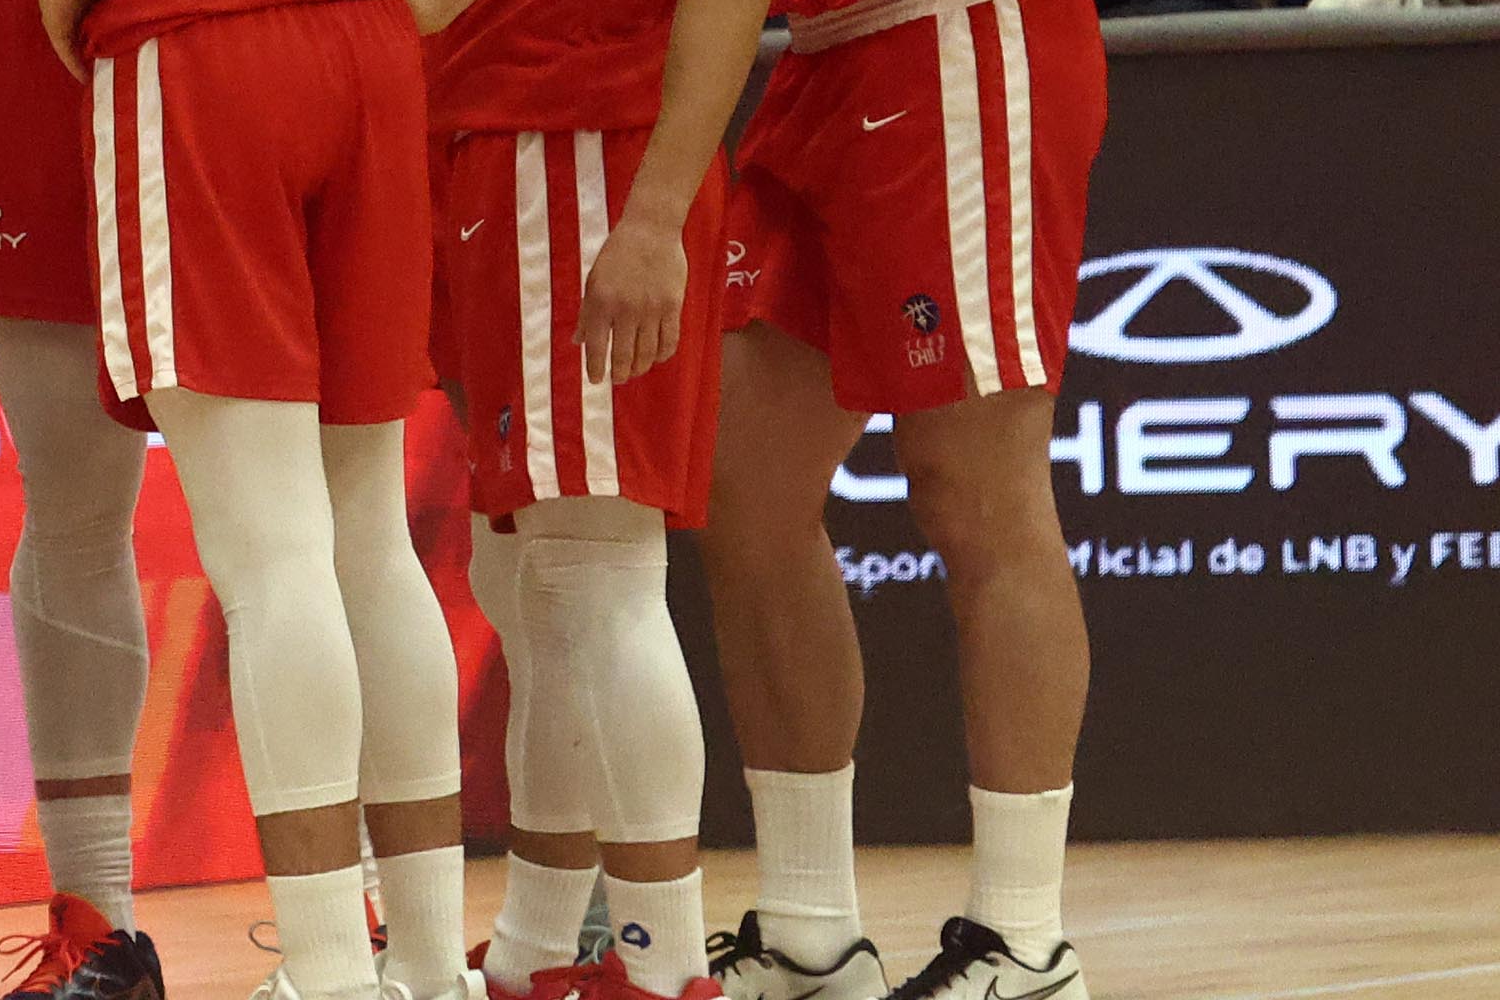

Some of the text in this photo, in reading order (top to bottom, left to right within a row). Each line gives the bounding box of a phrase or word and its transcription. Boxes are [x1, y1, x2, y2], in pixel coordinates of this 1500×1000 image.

[1208, 536, 1266, 575] de
[1281, 532, 1378, 574] LNB
[1390, 542, 1416, 585] y
